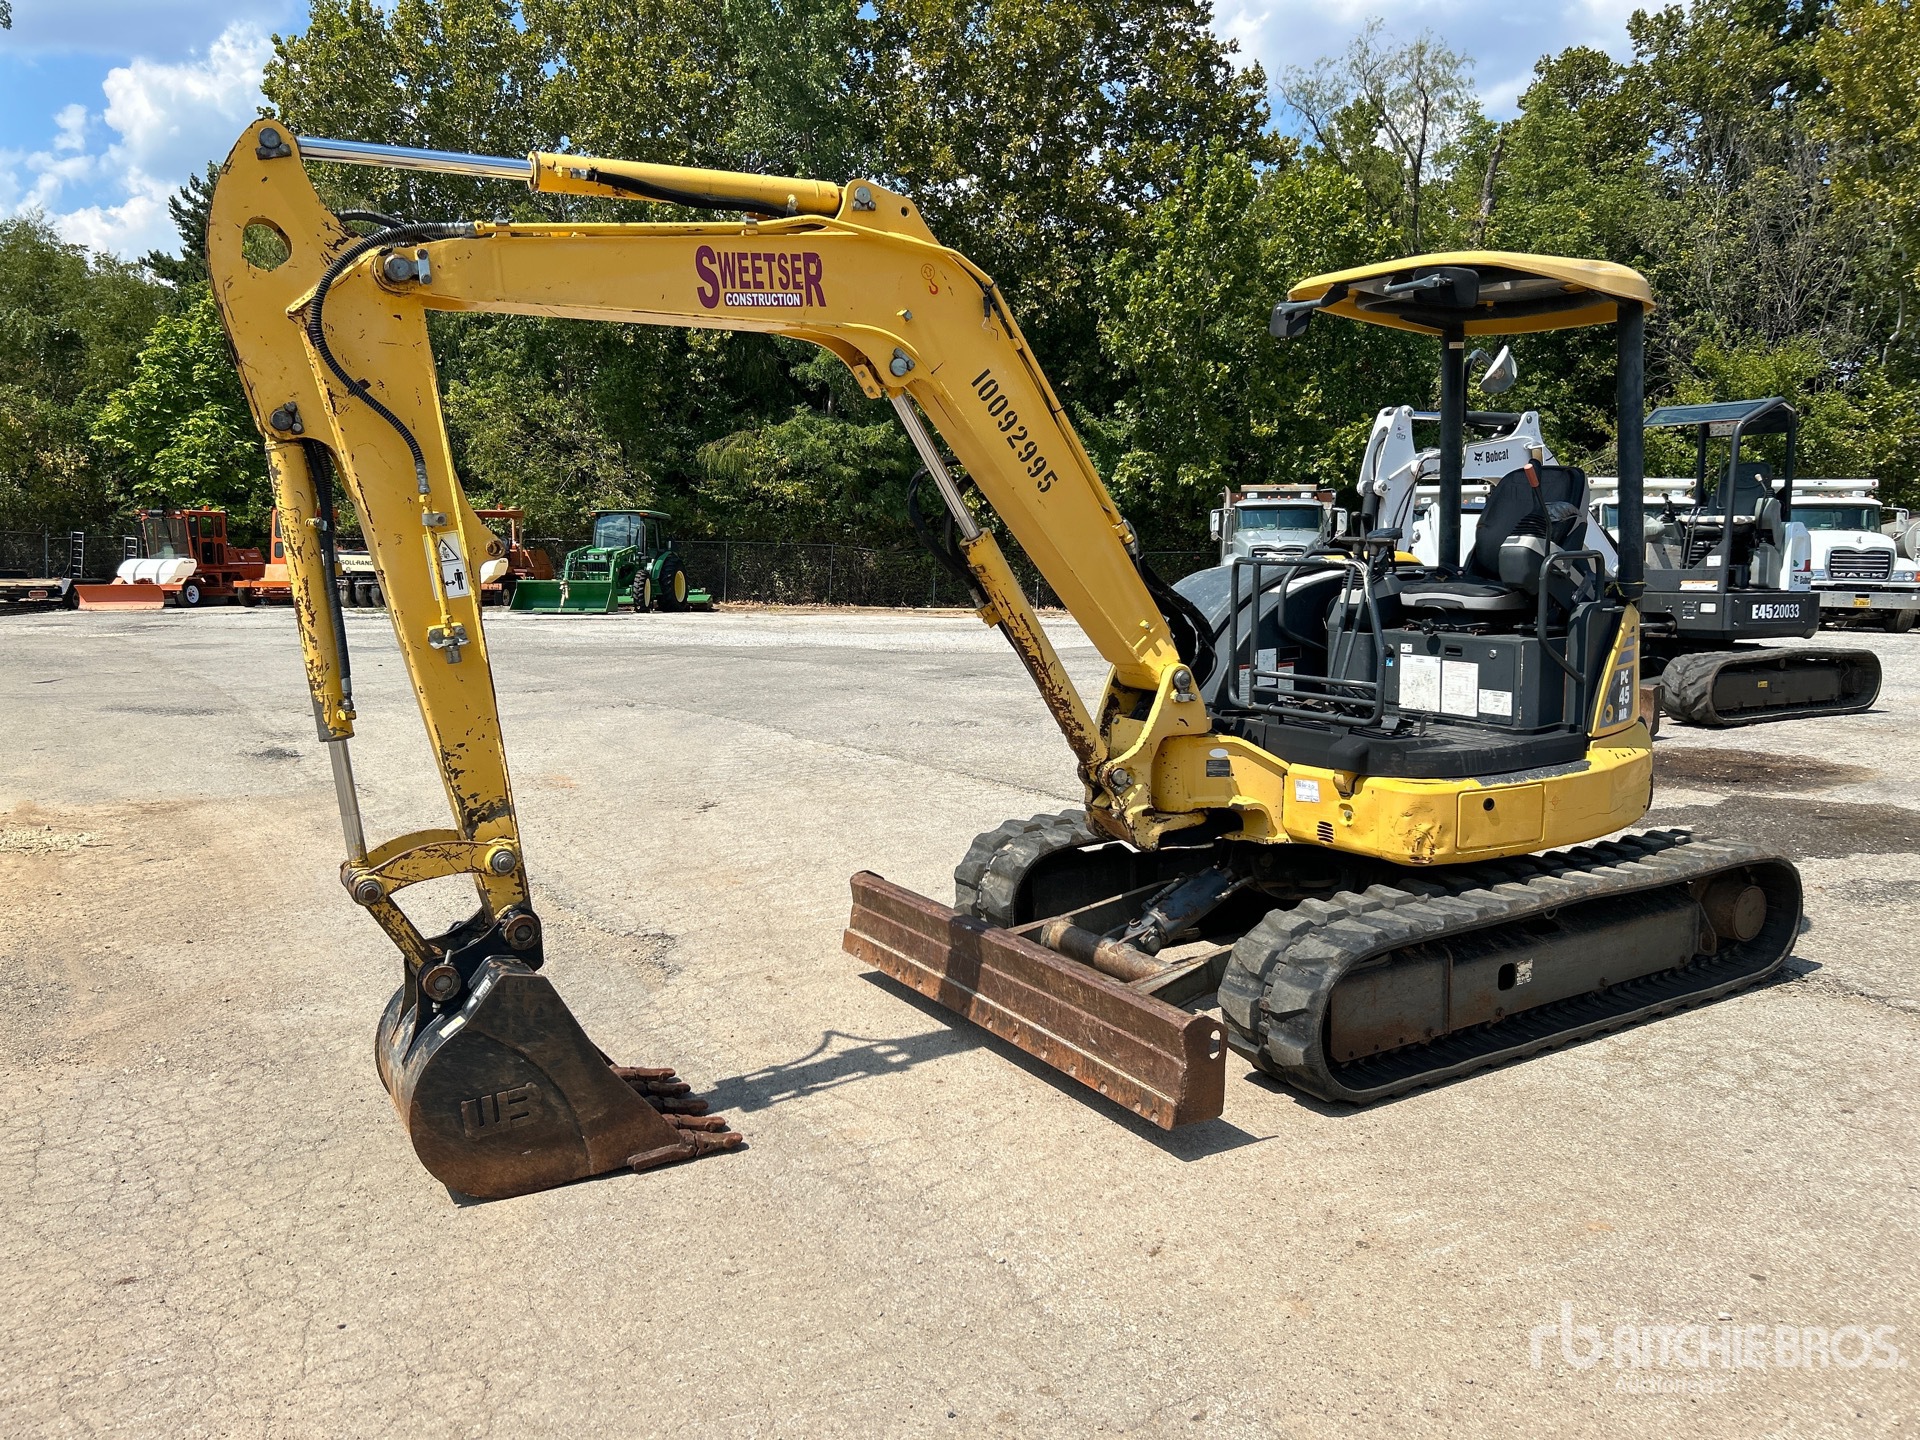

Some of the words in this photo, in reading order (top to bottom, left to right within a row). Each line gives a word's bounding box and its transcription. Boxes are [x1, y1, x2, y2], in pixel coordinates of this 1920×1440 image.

[695, 245, 827, 309] SWEETSER
[725, 293, 801, 306] CONSTRUCTION
[971, 368, 1059, 493] 10092995
[1485, 448, 1509, 463] Bobcat
[1620, 669, 1629, 686] PC
[1618, 685, 1630, 706] 45
